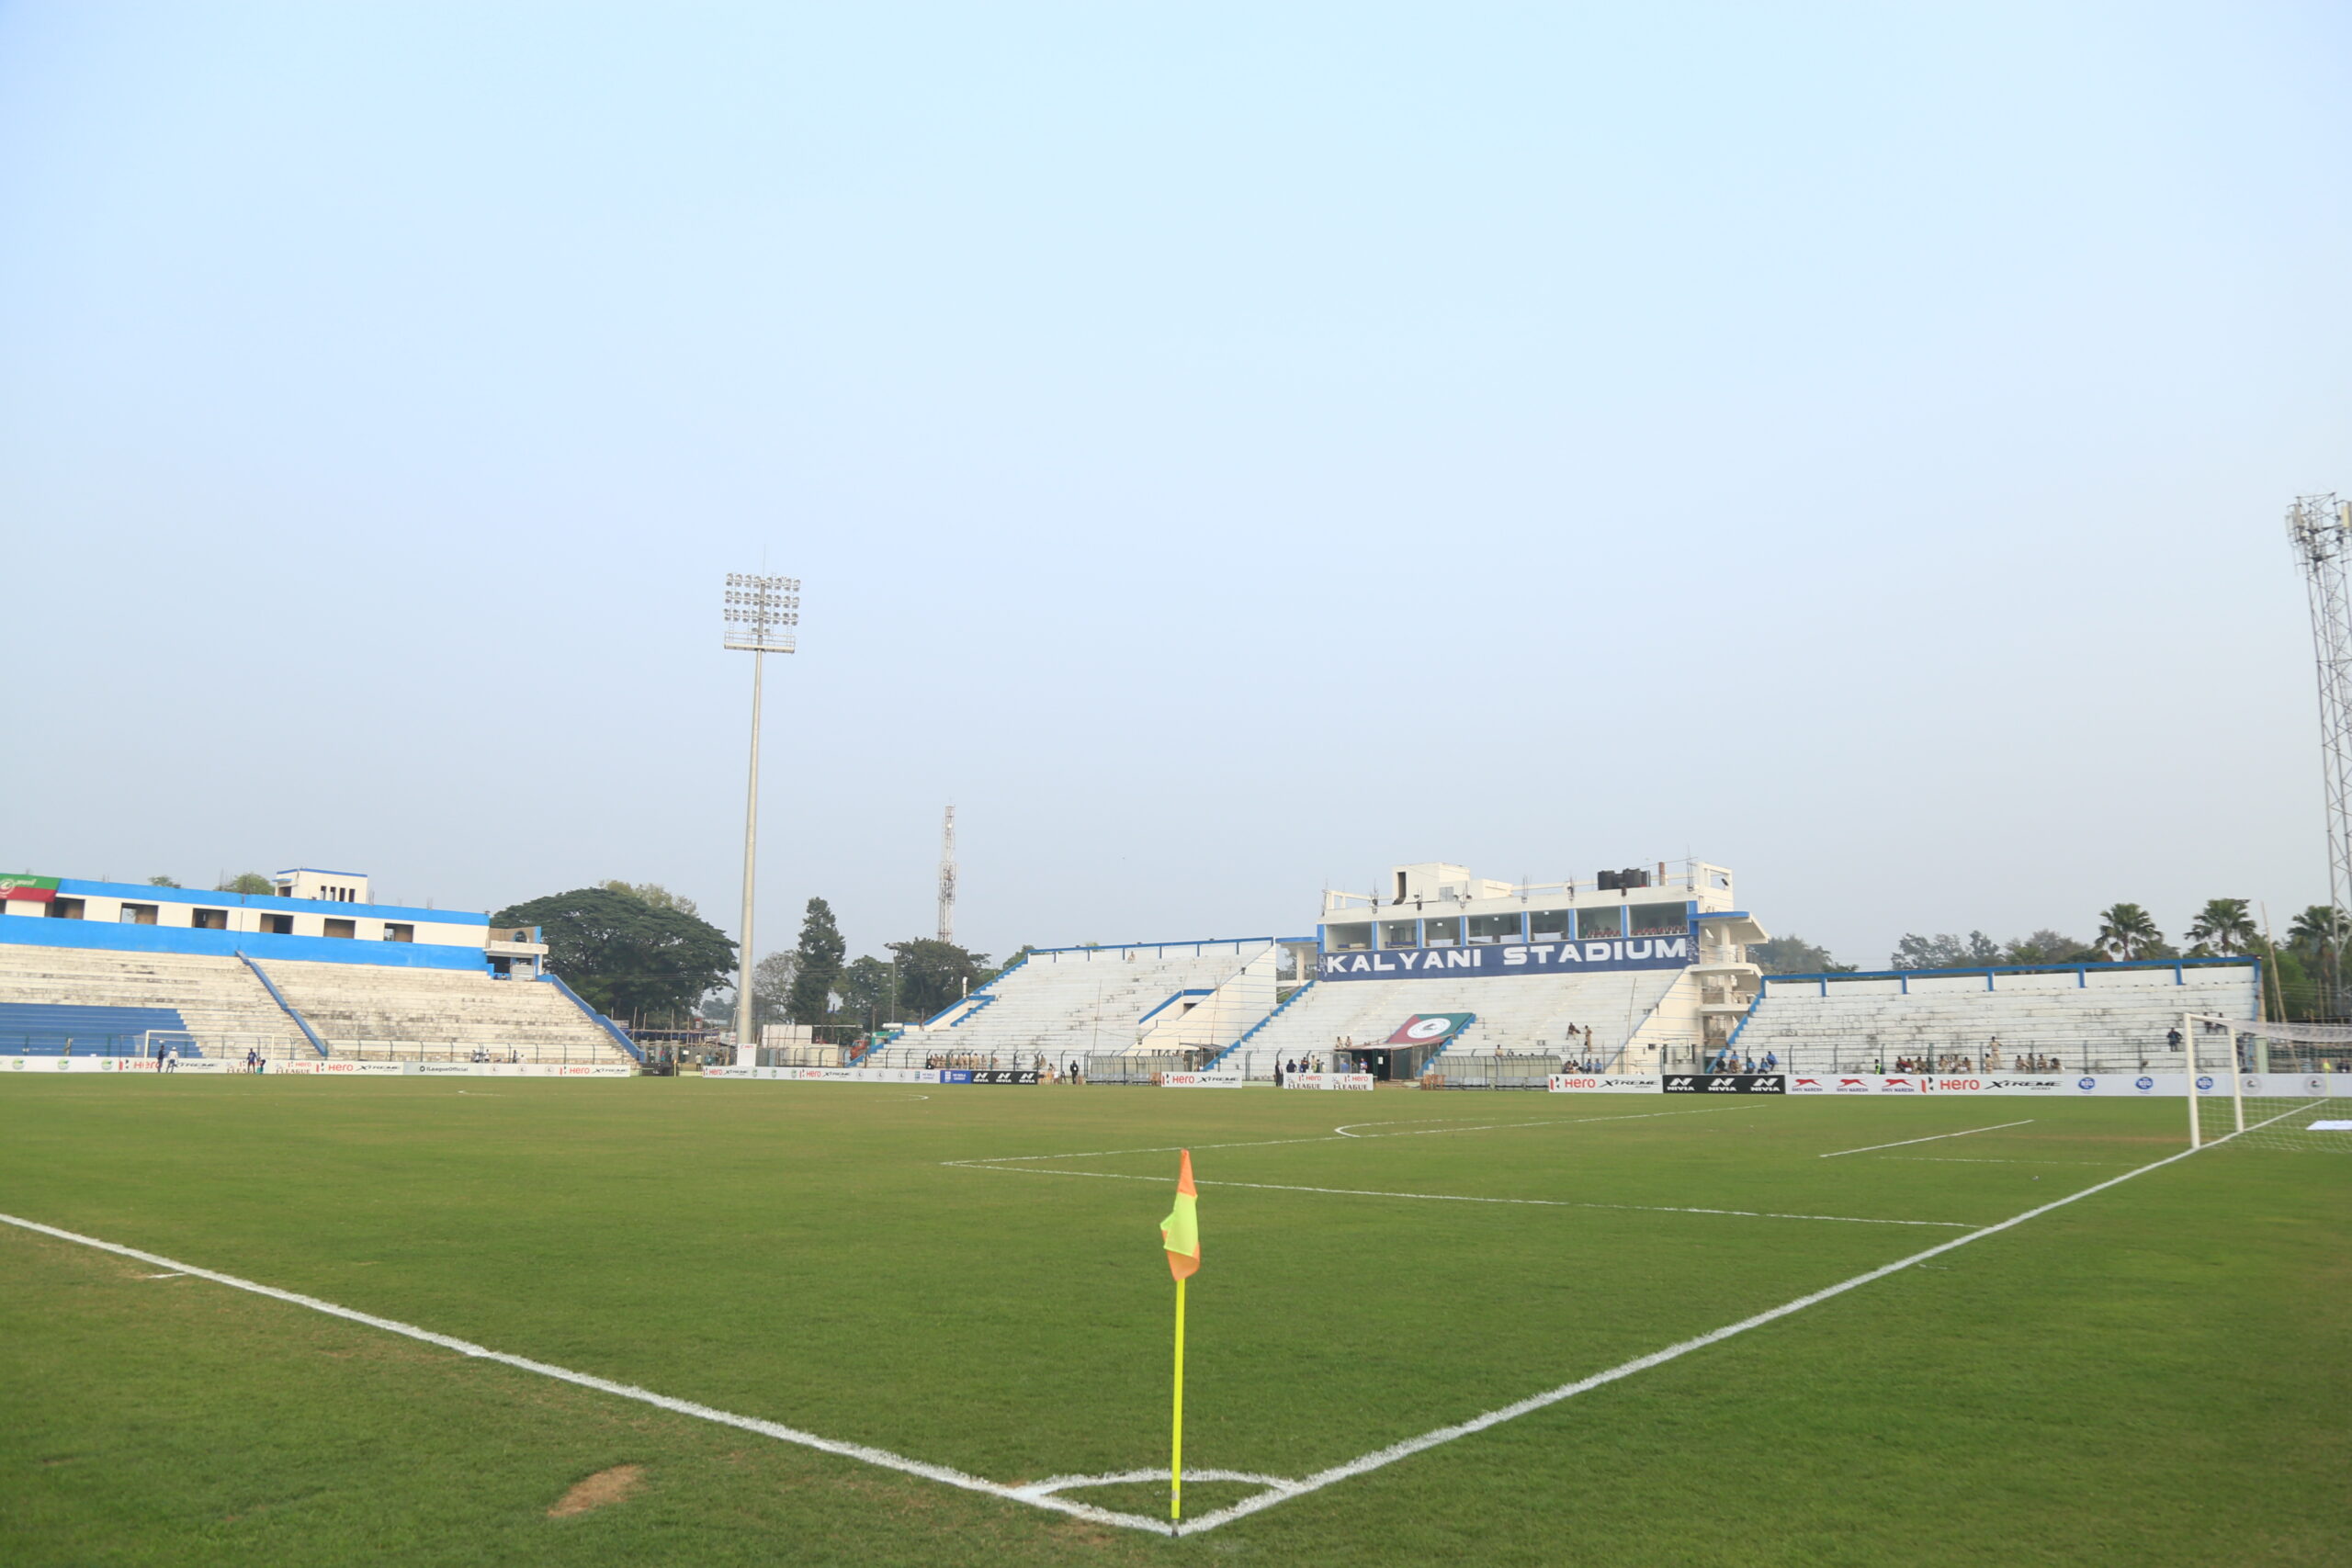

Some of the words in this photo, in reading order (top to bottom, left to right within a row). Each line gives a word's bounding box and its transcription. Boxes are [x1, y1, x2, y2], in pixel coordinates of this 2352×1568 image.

[1328, 949, 1481, 973] KALYANI
[1503, 938, 1687, 965] STADIUM
[328, 1064, 354, 1072] Hero
[1172, 1075, 1194, 1084] Hero
[1565, 1078, 1596, 1089] Hero
[1599, 1079, 1661, 1088] XTREME
[1939, 1078, 1981, 1090] Hero
[1984, 1079, 2064, 1089] XTREME
